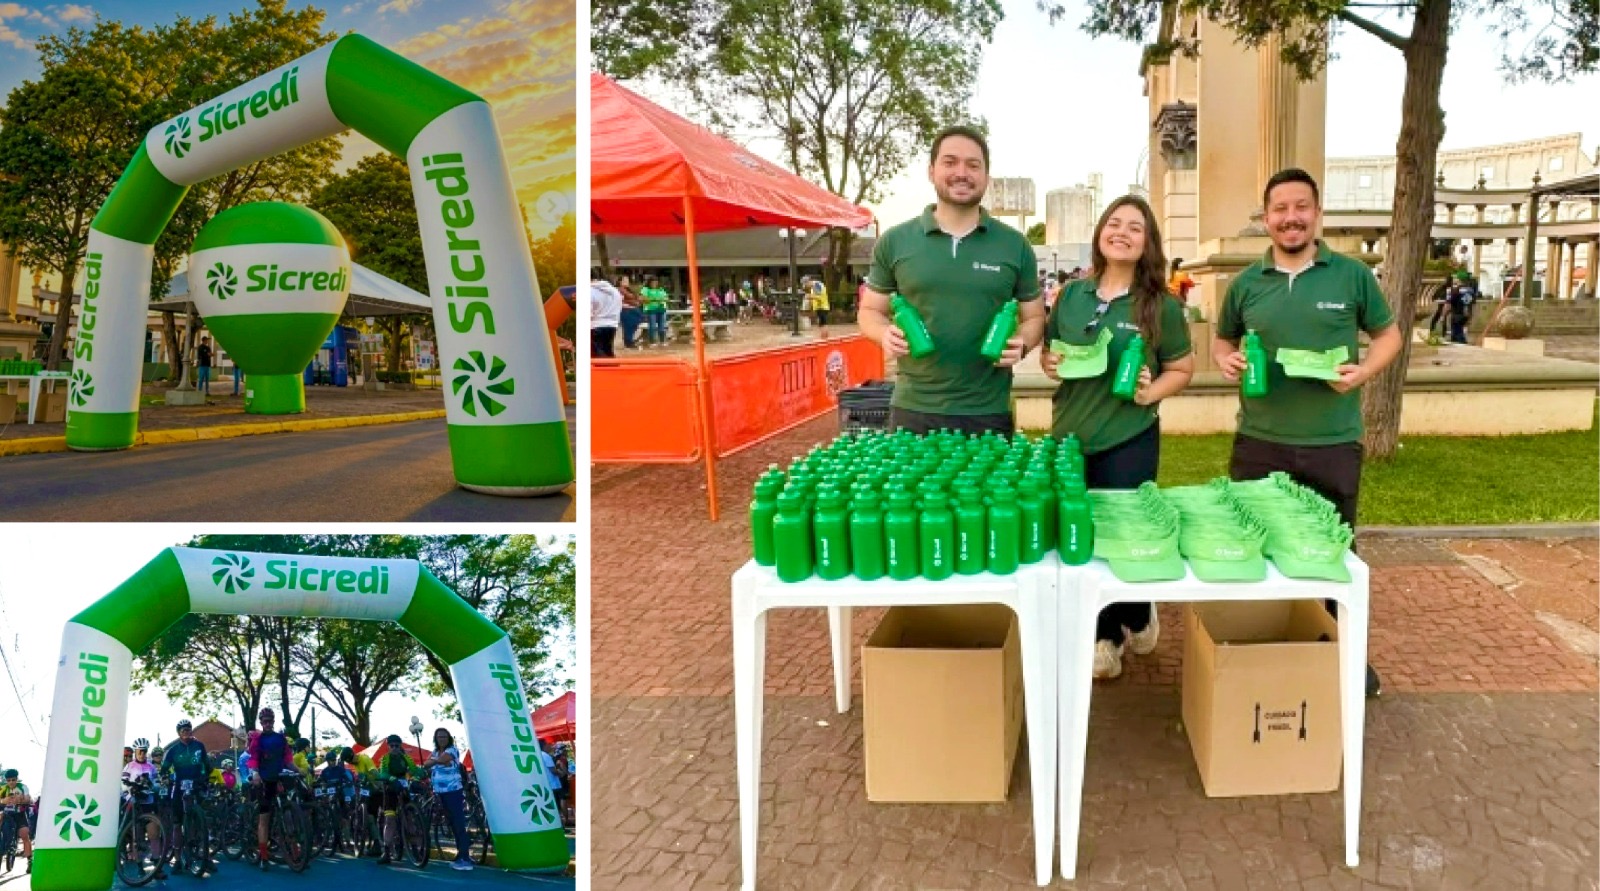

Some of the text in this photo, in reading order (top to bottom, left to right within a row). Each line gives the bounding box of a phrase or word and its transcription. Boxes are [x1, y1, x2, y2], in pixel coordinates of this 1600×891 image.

[198, 67, 299, 142] Sicredi
[246, 264, 346, 292] Sicredi
[421, 152, 496, 336] Sicredi
[74, 252, 103, 362] Sicredi
[264, 559, 390, 594] Sicredi
[66, 652, 110, 784] Sicredi
[488, 662, 542, 775] Sicredi
